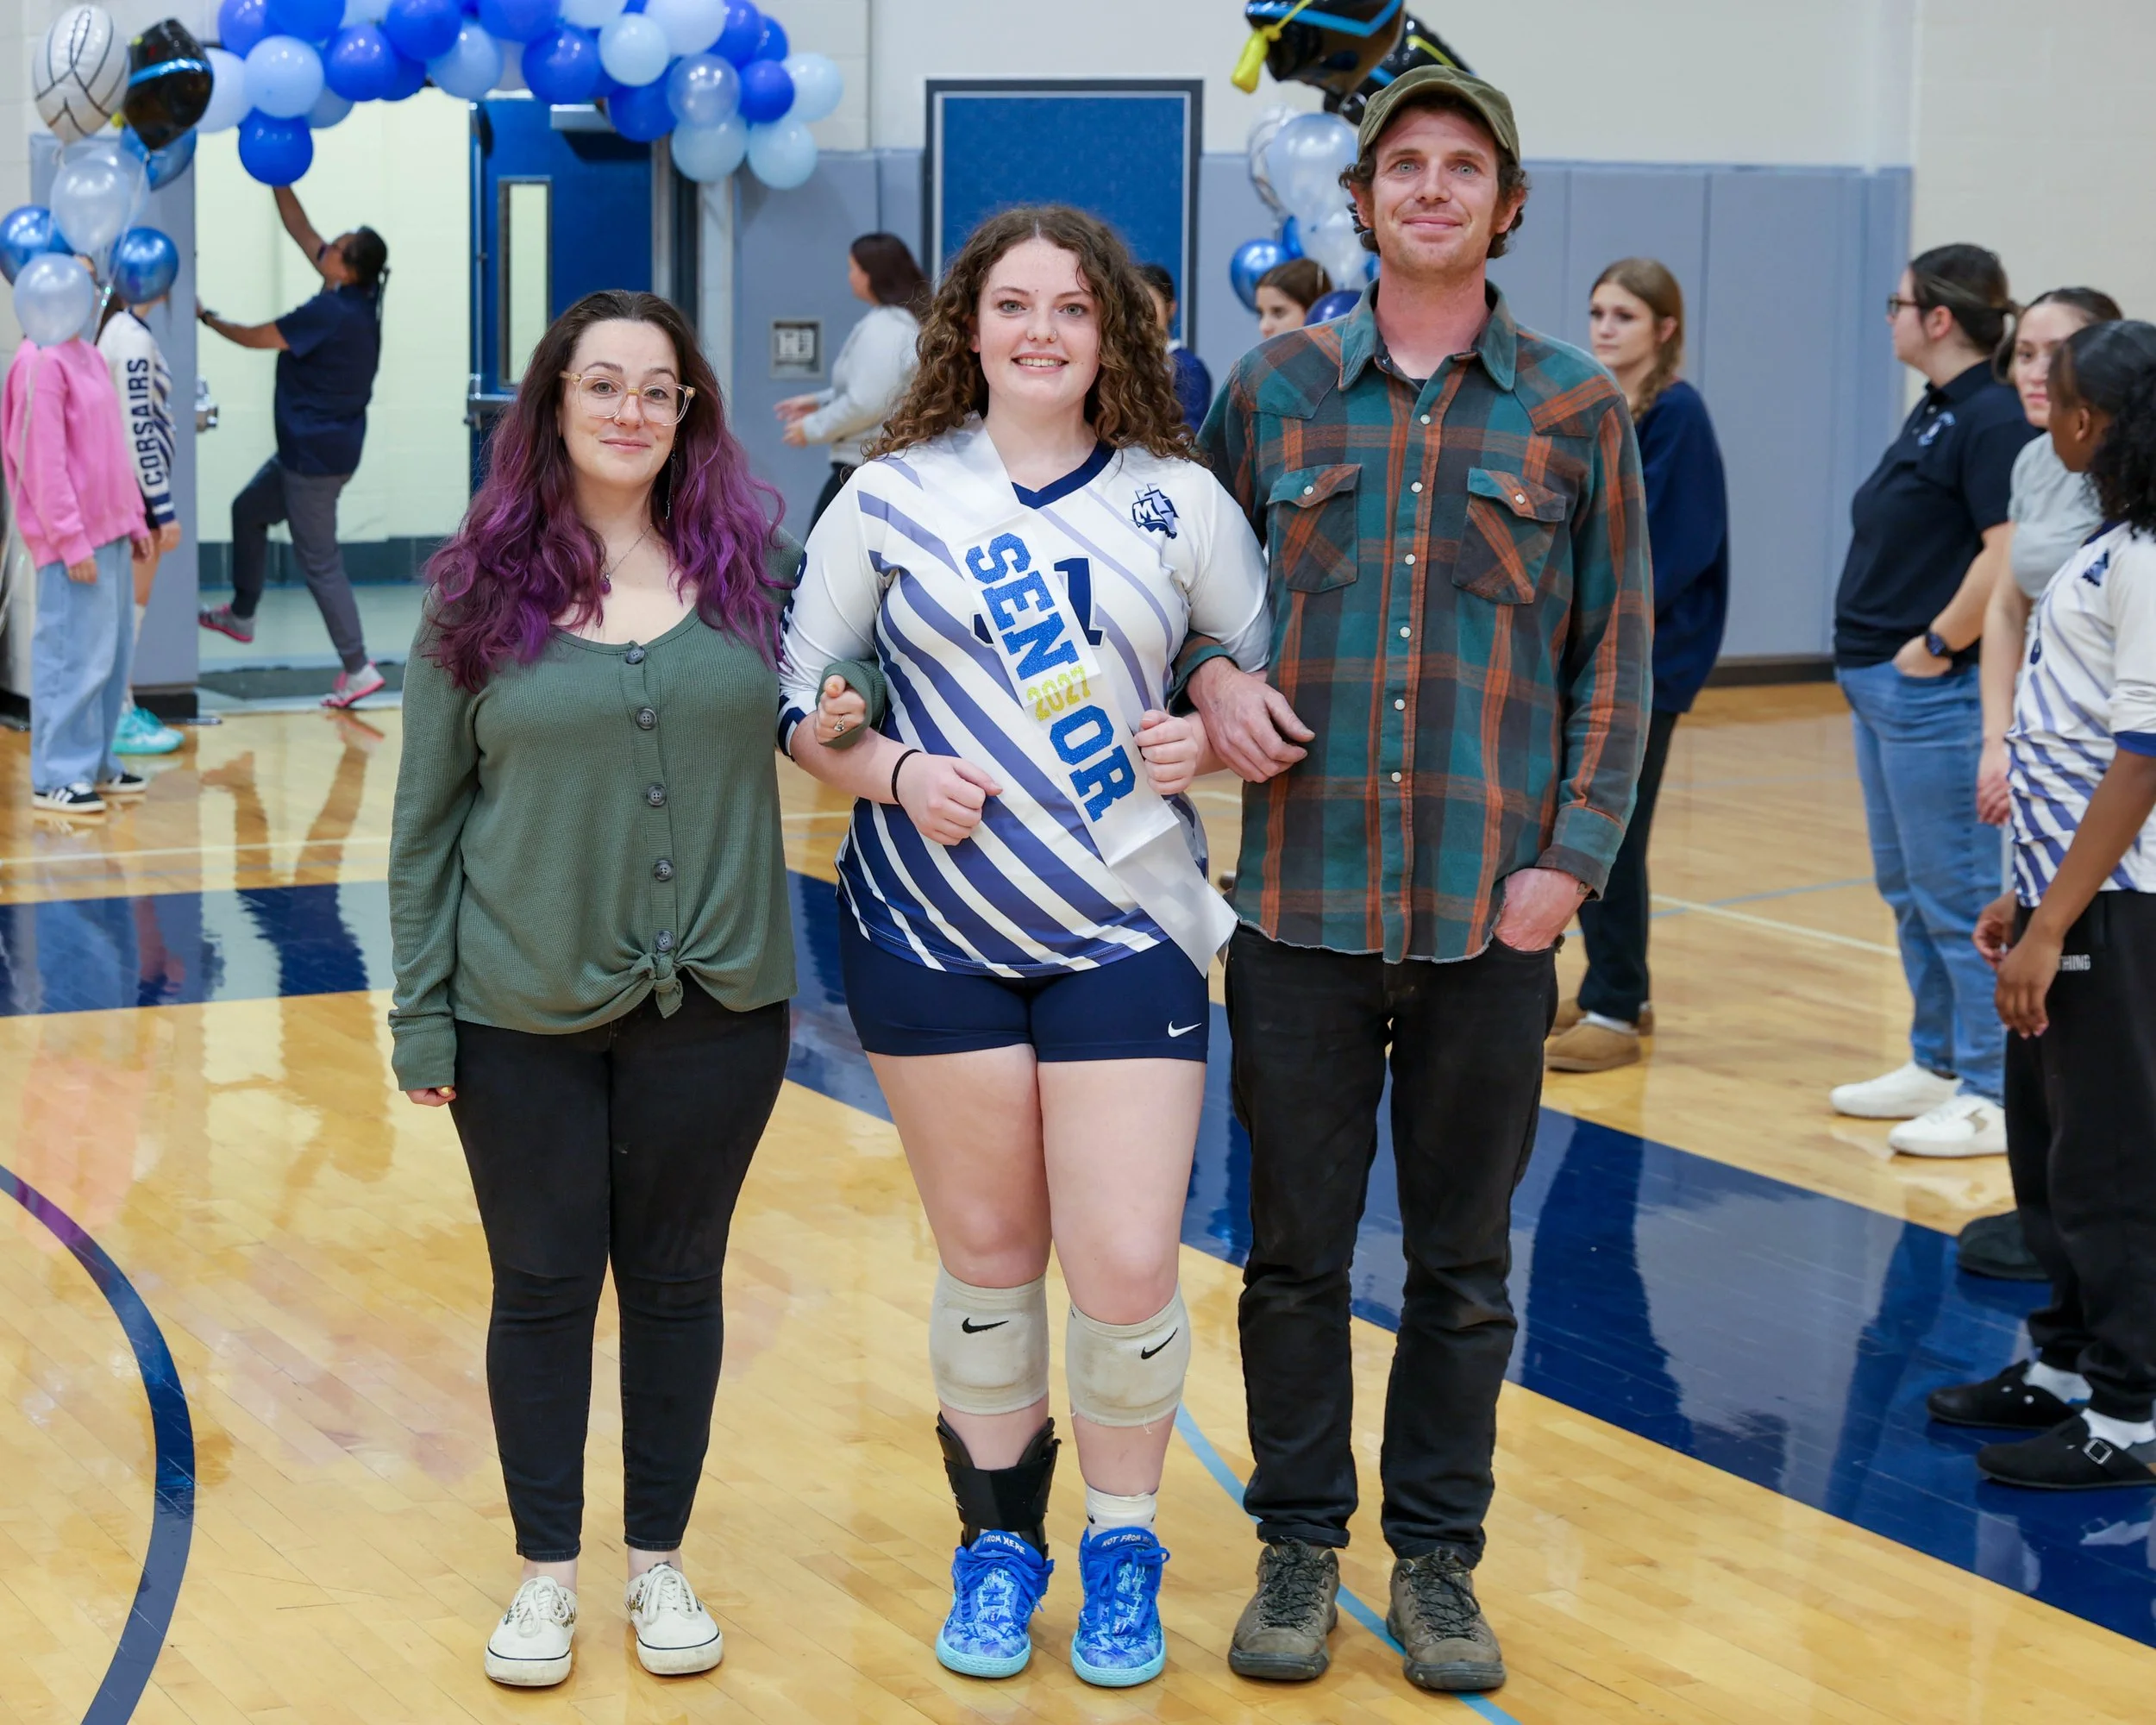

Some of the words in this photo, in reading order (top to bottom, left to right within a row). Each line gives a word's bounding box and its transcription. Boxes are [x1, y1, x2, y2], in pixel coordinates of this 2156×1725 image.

[127, 357, 163, 486] CORSAIRS
[1026, 663, 1092, 722] 2027
[1101, 1536, 1120, 1548] NOT
